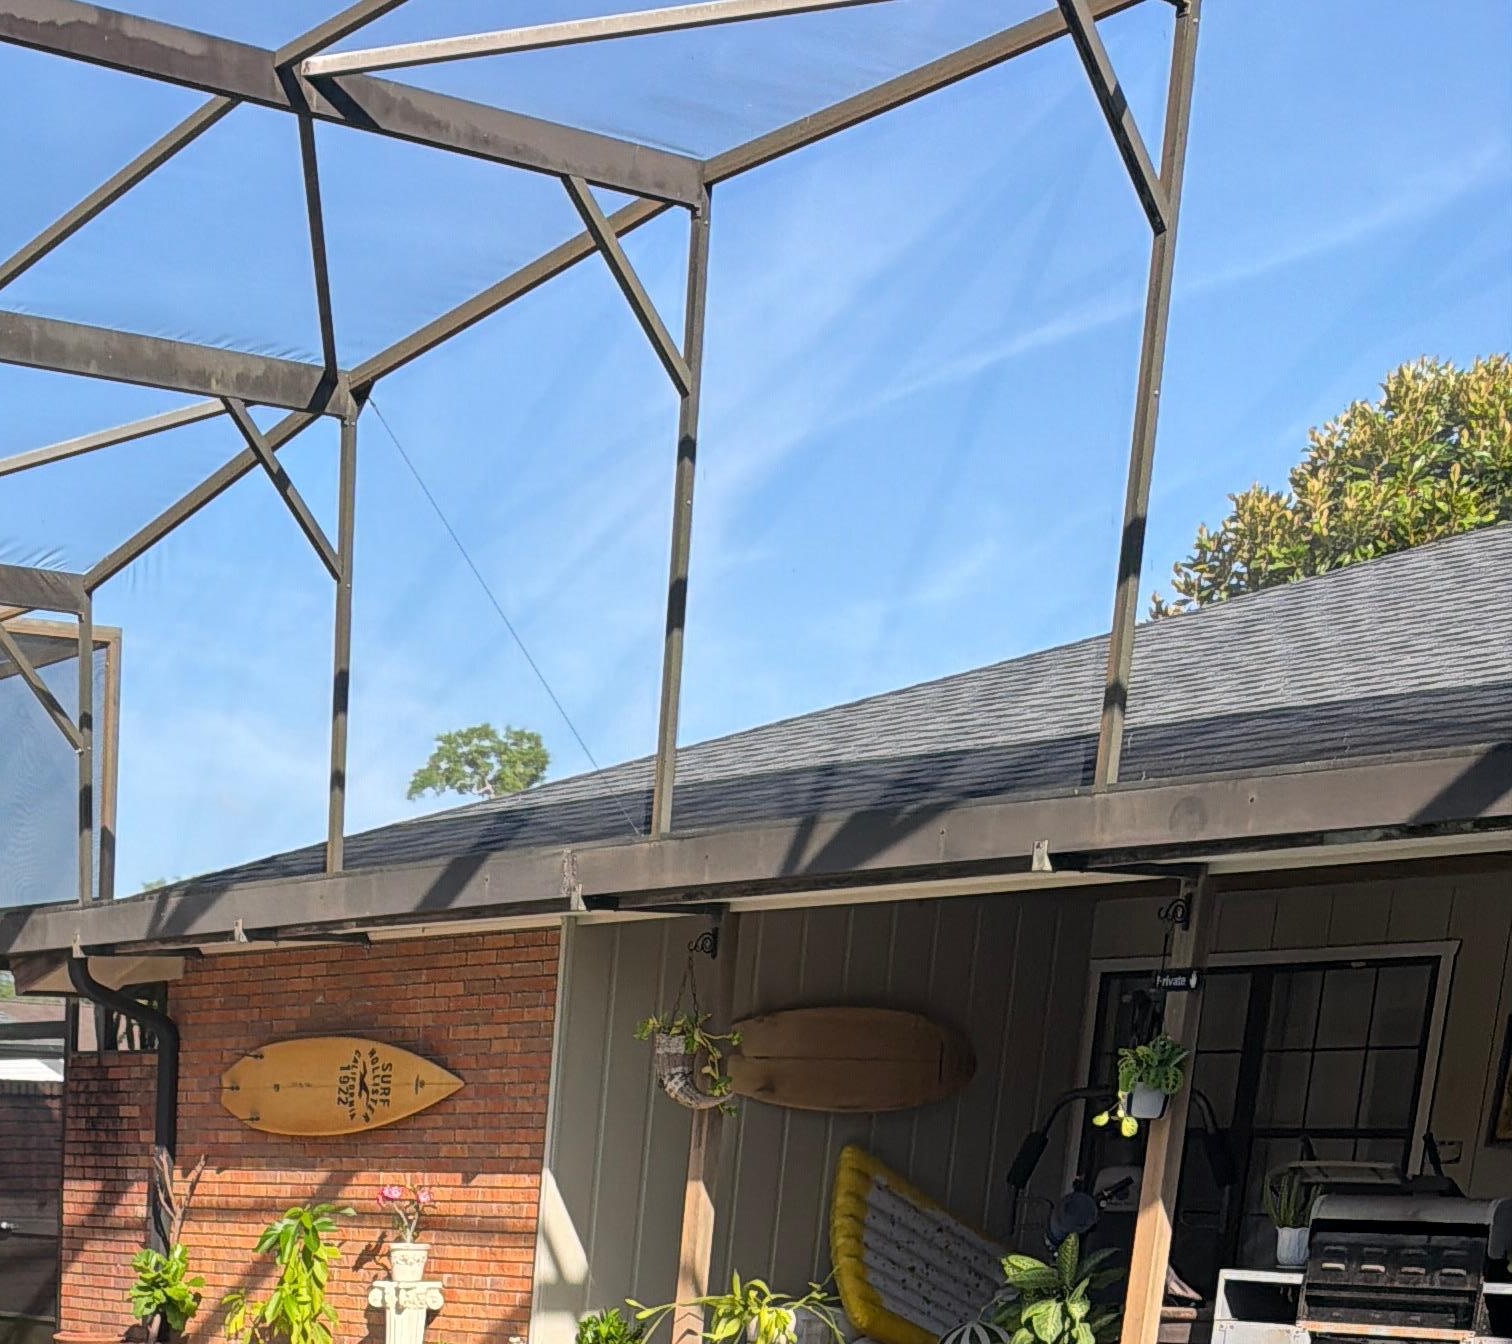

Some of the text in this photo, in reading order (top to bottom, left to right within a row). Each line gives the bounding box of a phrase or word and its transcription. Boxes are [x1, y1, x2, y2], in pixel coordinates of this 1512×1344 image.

[337, 1065, 350, 1106] 1922
[348, 1049, 362, 1120] CALIFORNIA
[362, 1048, 381, 1122] HOLLISTER
[379, 1062, 393, 1107] SURF
